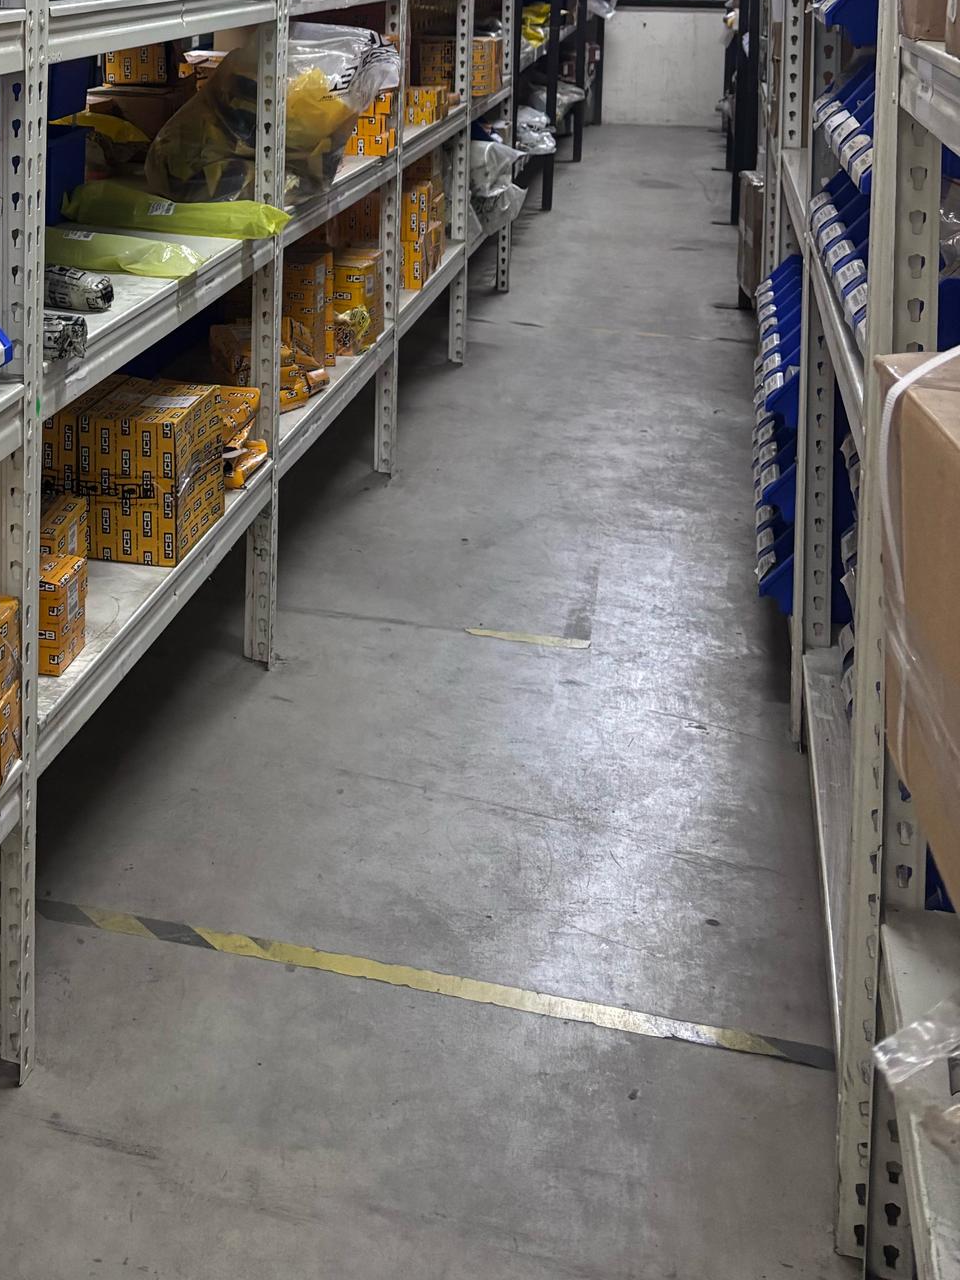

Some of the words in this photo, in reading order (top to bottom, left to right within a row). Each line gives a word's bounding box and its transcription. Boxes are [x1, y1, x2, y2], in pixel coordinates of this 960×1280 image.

[101, 429, 109, 453] JCB
[142, 432, 151, 456] JCB
[122, 451, 130, 475] JCB
[164, 453, 172, 478] JCB
[102, 509, 110, 533] JCB
[143, 512, 152, 537] JCB
[123, 531, 131, 555] JCB
[165, 534, 173, 558] JCB
